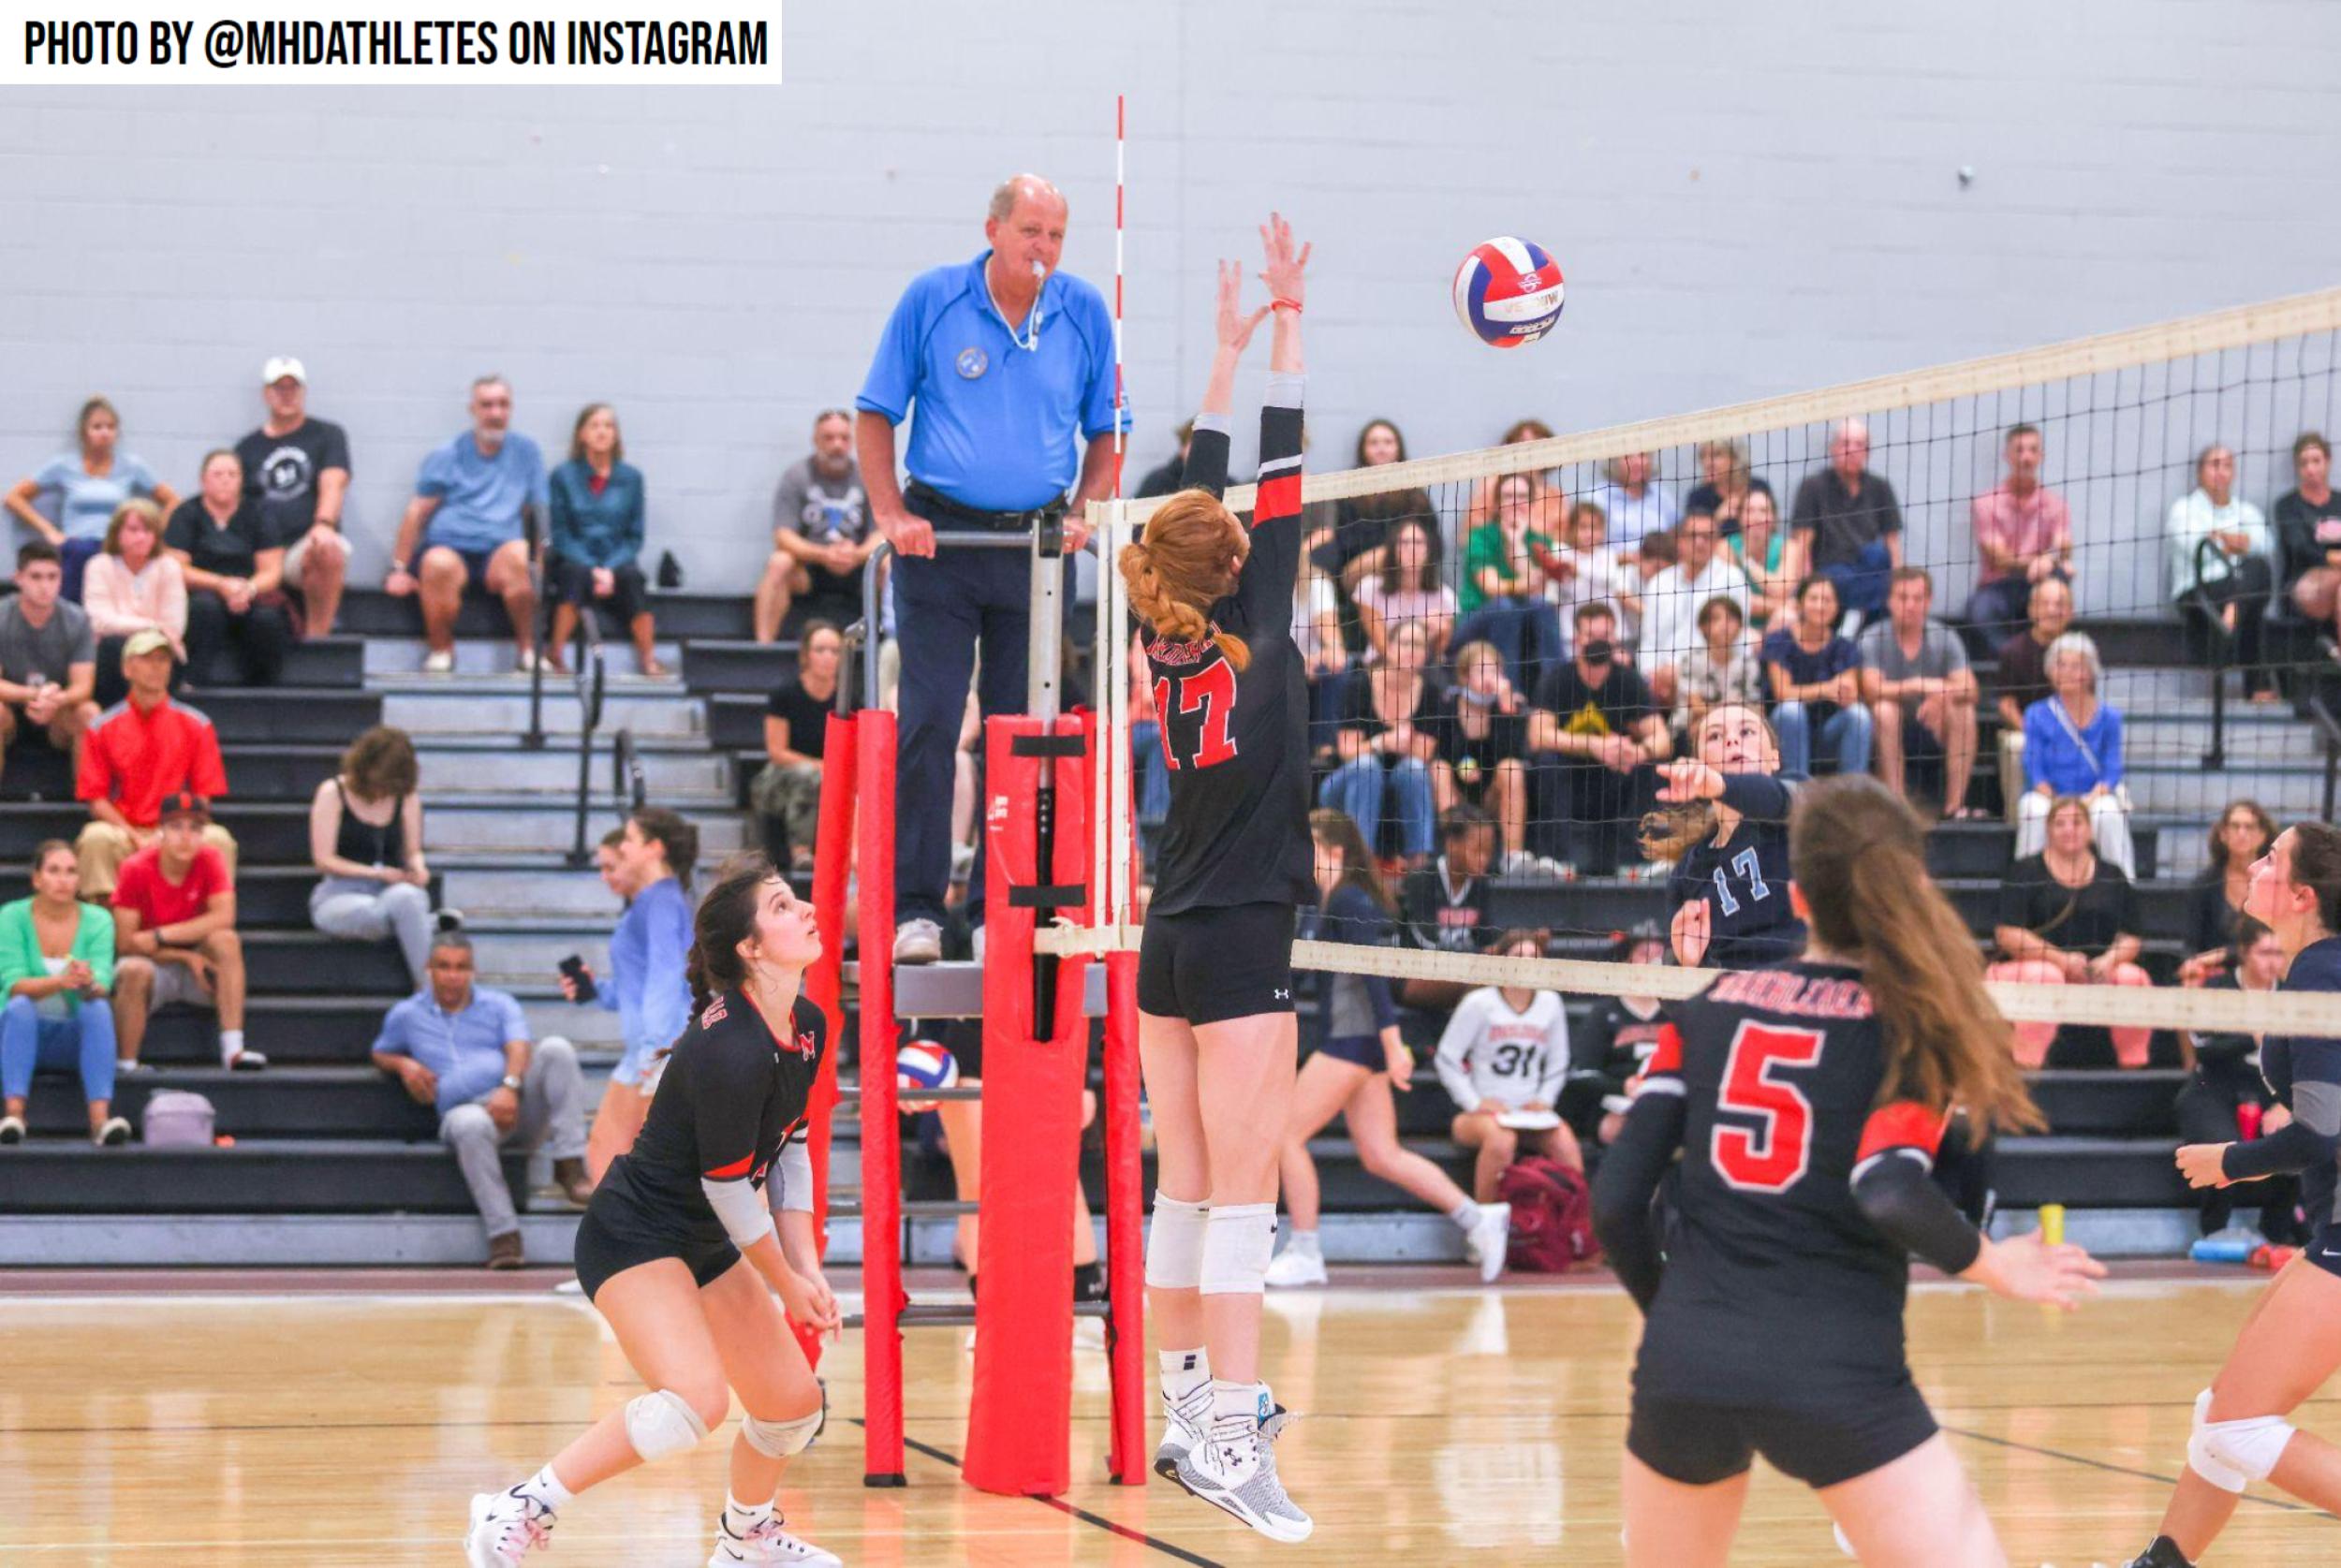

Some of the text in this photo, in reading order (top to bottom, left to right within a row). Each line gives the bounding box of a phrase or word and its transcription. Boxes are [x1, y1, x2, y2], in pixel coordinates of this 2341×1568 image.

[1153, 656, 1238, 769] 17
[1713, 845, 1771, 916] 17
[1491, 1044, 1537, 1077] 31
[1711, 1018, 1826, 1194] 5
